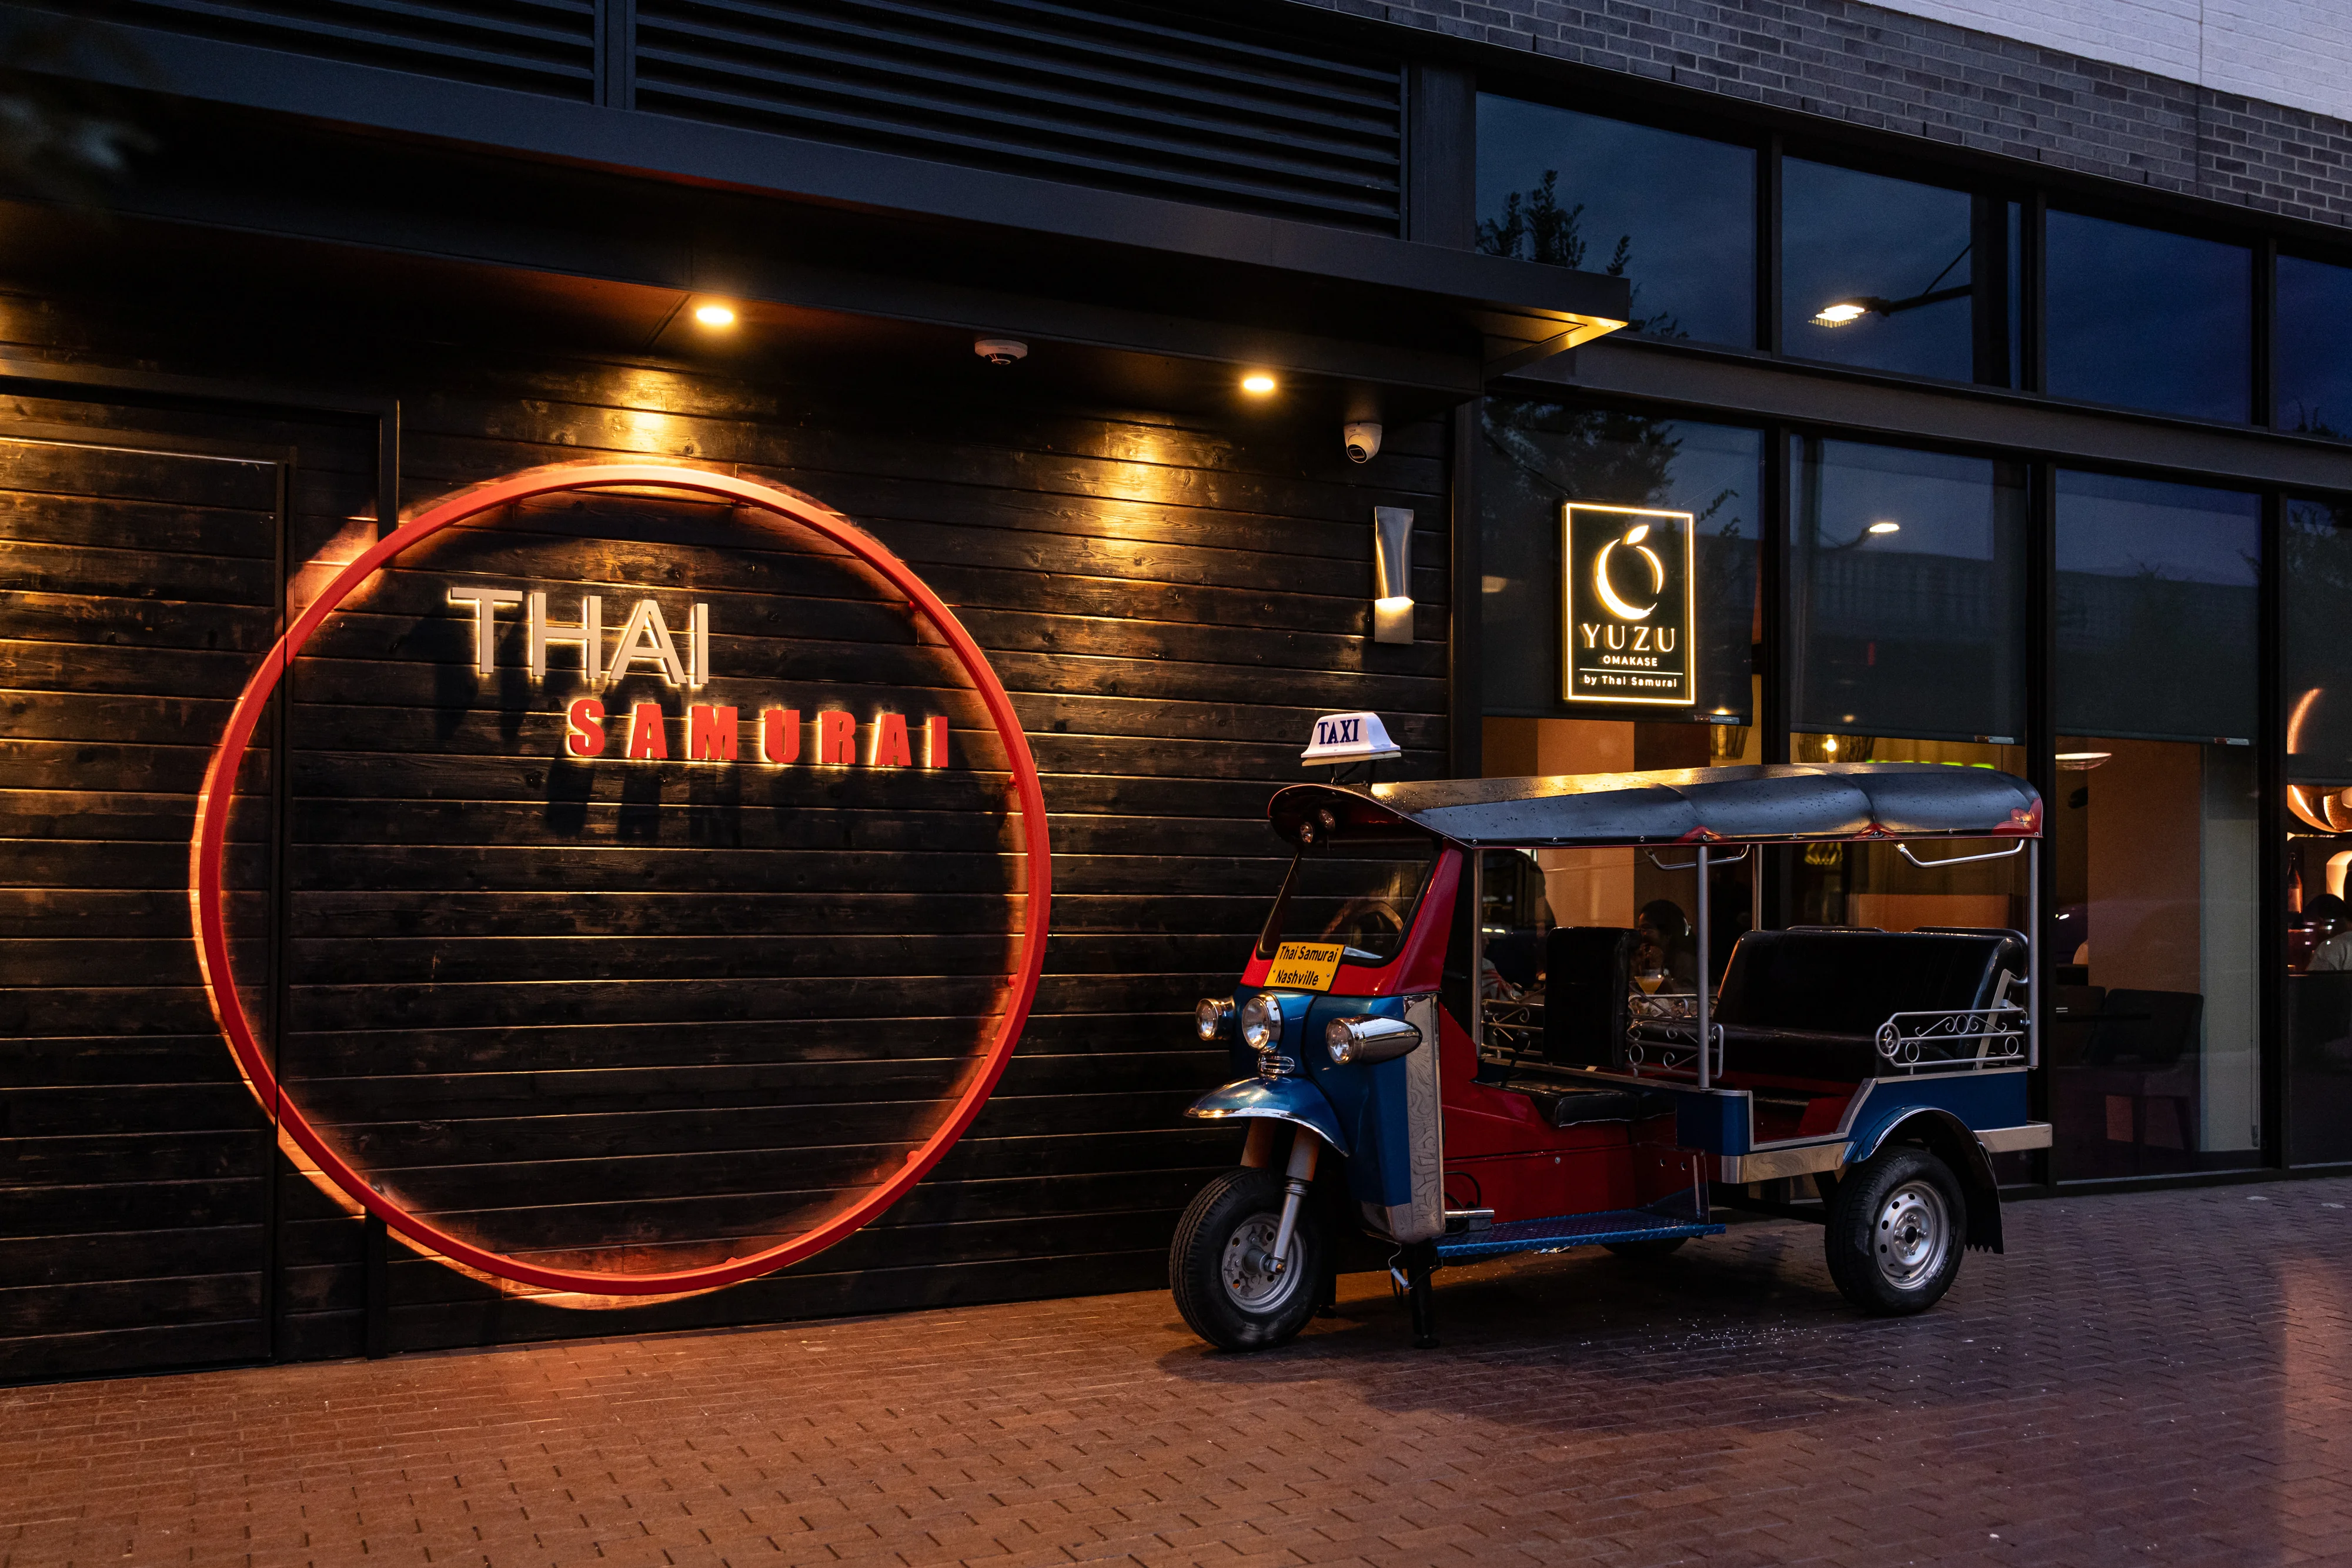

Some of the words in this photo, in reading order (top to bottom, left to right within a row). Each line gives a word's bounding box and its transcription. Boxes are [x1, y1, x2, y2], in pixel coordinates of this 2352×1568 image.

[450, 587, 709, 685] THAI
[1582, 623, 1675, 653] YUZU
[1602, 654, 1658, 667] OMAKASE
[1583, 674, 1598, 686] by
[1601, 675, 1626, 686] Thai
[1631, 676, 1678, 688] Samurai
[569, 698, 949, 767] SAMURAI
[1317, 718, 1360, 745] TAXI
[1279, 945, 1299, 960] Thai
[1298, 945, 1339, 962] Samurai
[1275, 969, 1319, 986] Nashville
